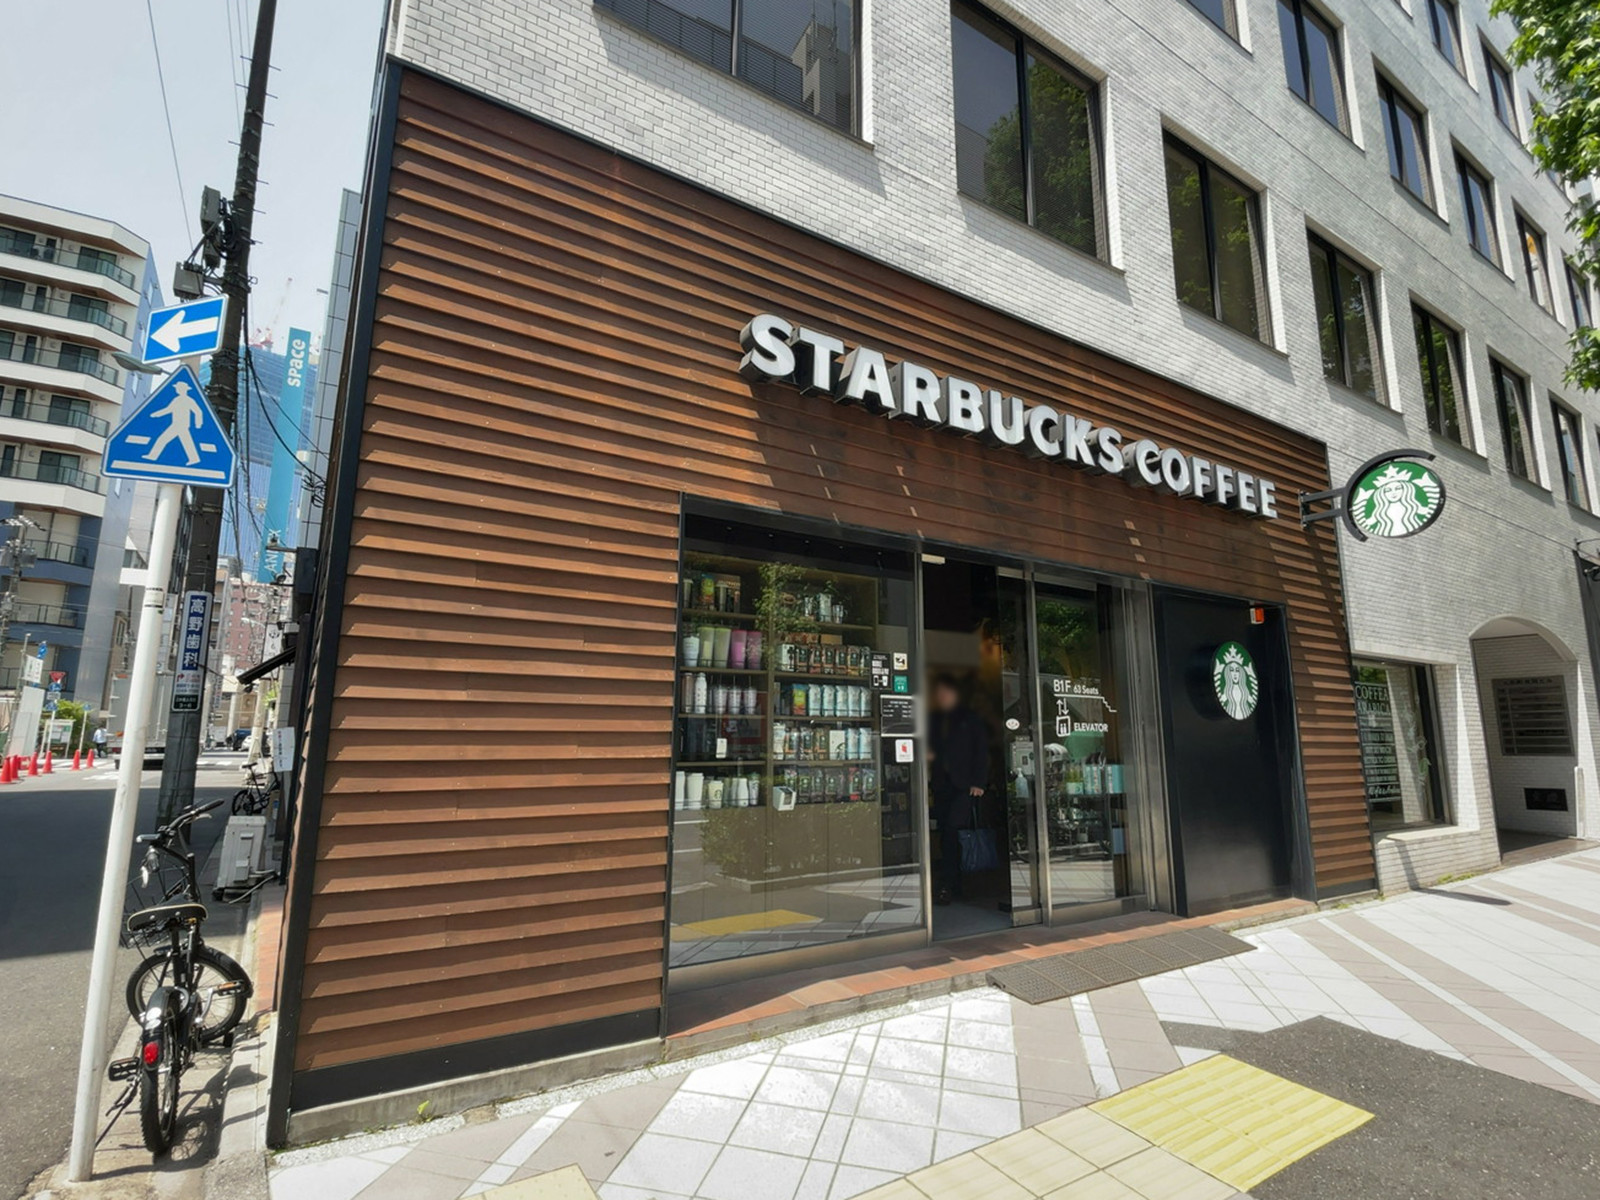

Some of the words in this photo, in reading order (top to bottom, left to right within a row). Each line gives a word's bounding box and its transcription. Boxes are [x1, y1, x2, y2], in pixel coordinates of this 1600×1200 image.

[287, 338, 306, 388] space
[740, 313, 1125, 474] STARBUCKS
[1127, 438, 1279, 519] COFFEE
[183, 598, 206, 667] 高野歯科
[1053, 679, 1072, 693] B1F
[1073, 684, 1082, 694] 63
[1082, 685, 1099, 695] Seats
[1355, 685, 1389, 701] COFFEA
[1073, 722, 1109, 733] ELEVATOR
